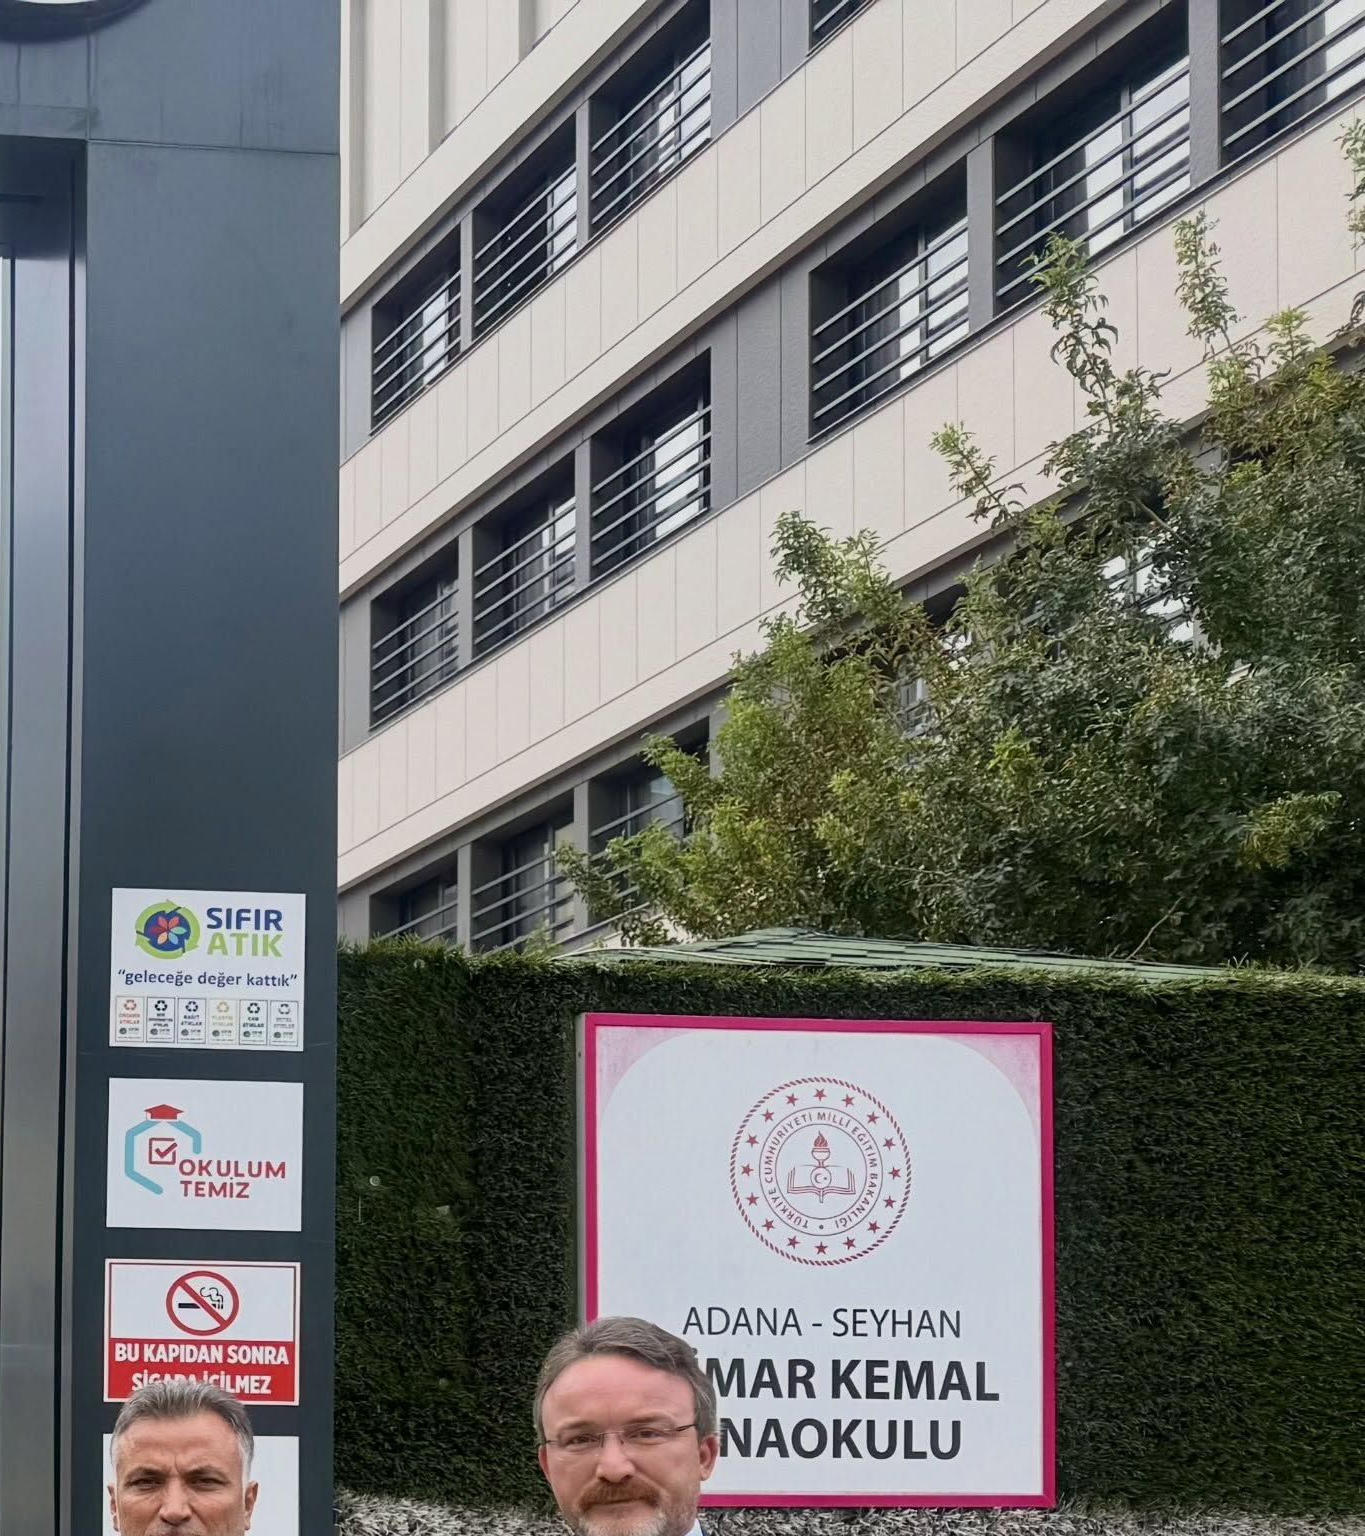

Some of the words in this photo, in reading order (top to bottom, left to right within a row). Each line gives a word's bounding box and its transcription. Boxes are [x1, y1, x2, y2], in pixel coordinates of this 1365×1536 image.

[206, 907, 284, 932] SIFIR
[207, 932, 284, 958] ATIK
[197, 971, 242, 988] değer
[178, 1158, 286, 1179] OKULUM
[179, 1176, 250, 1199] TEMİZ
[682, 1306, 802, 1336] ADANA
[832, 1307, 961, 1339] SEYHAN
[115, 1343, 140, 1362] BU
[143, 1343, 224, 1364] KAPIDAN
[227, 1345, 290, 1366] SONRA
[692, 1347, 817, 1399] MAR
[831, 1359, 1000, 1402] KEMAL
[719, 1417, 961, 1461] NAOKULU
